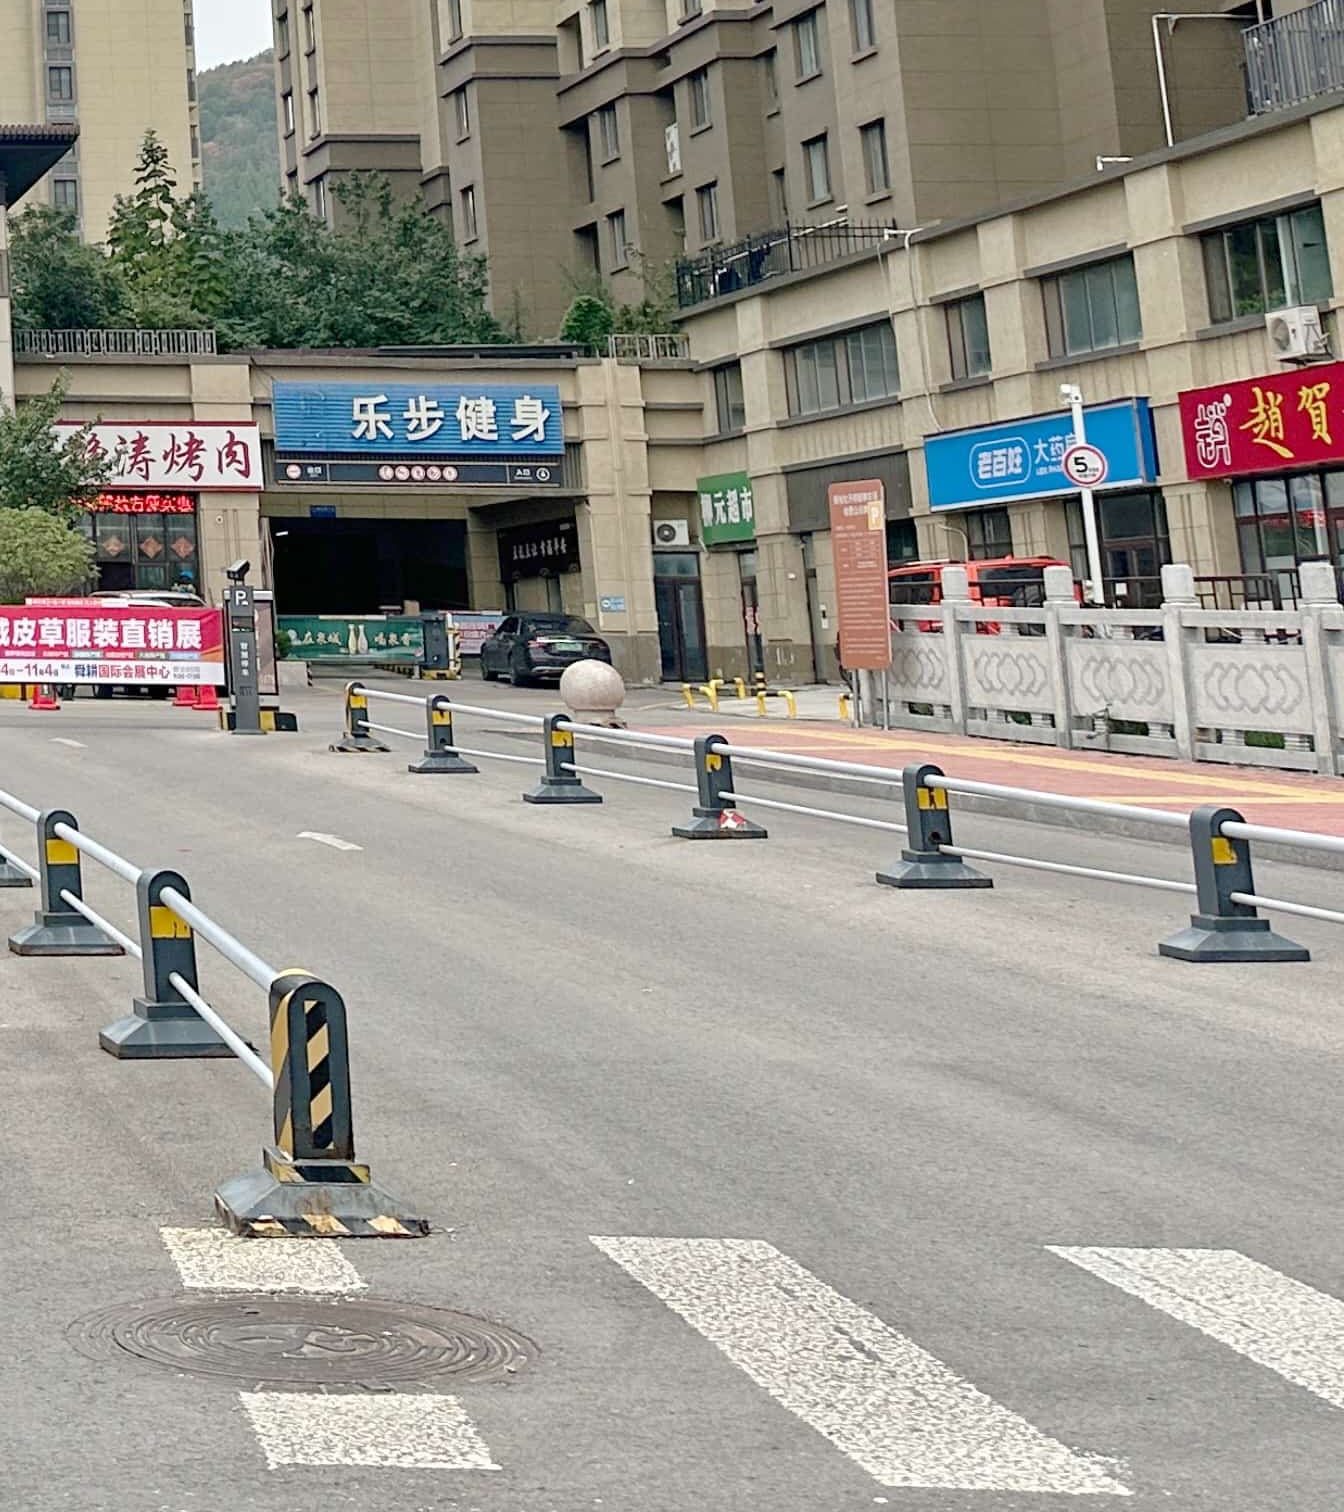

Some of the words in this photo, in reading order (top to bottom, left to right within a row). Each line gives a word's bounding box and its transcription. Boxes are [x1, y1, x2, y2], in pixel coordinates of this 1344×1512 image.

[351, 394, 551, 441] 乐步健身
[977, 446, 1024, 480] 老百姓
[1074, 456, 1088, 473] 5
